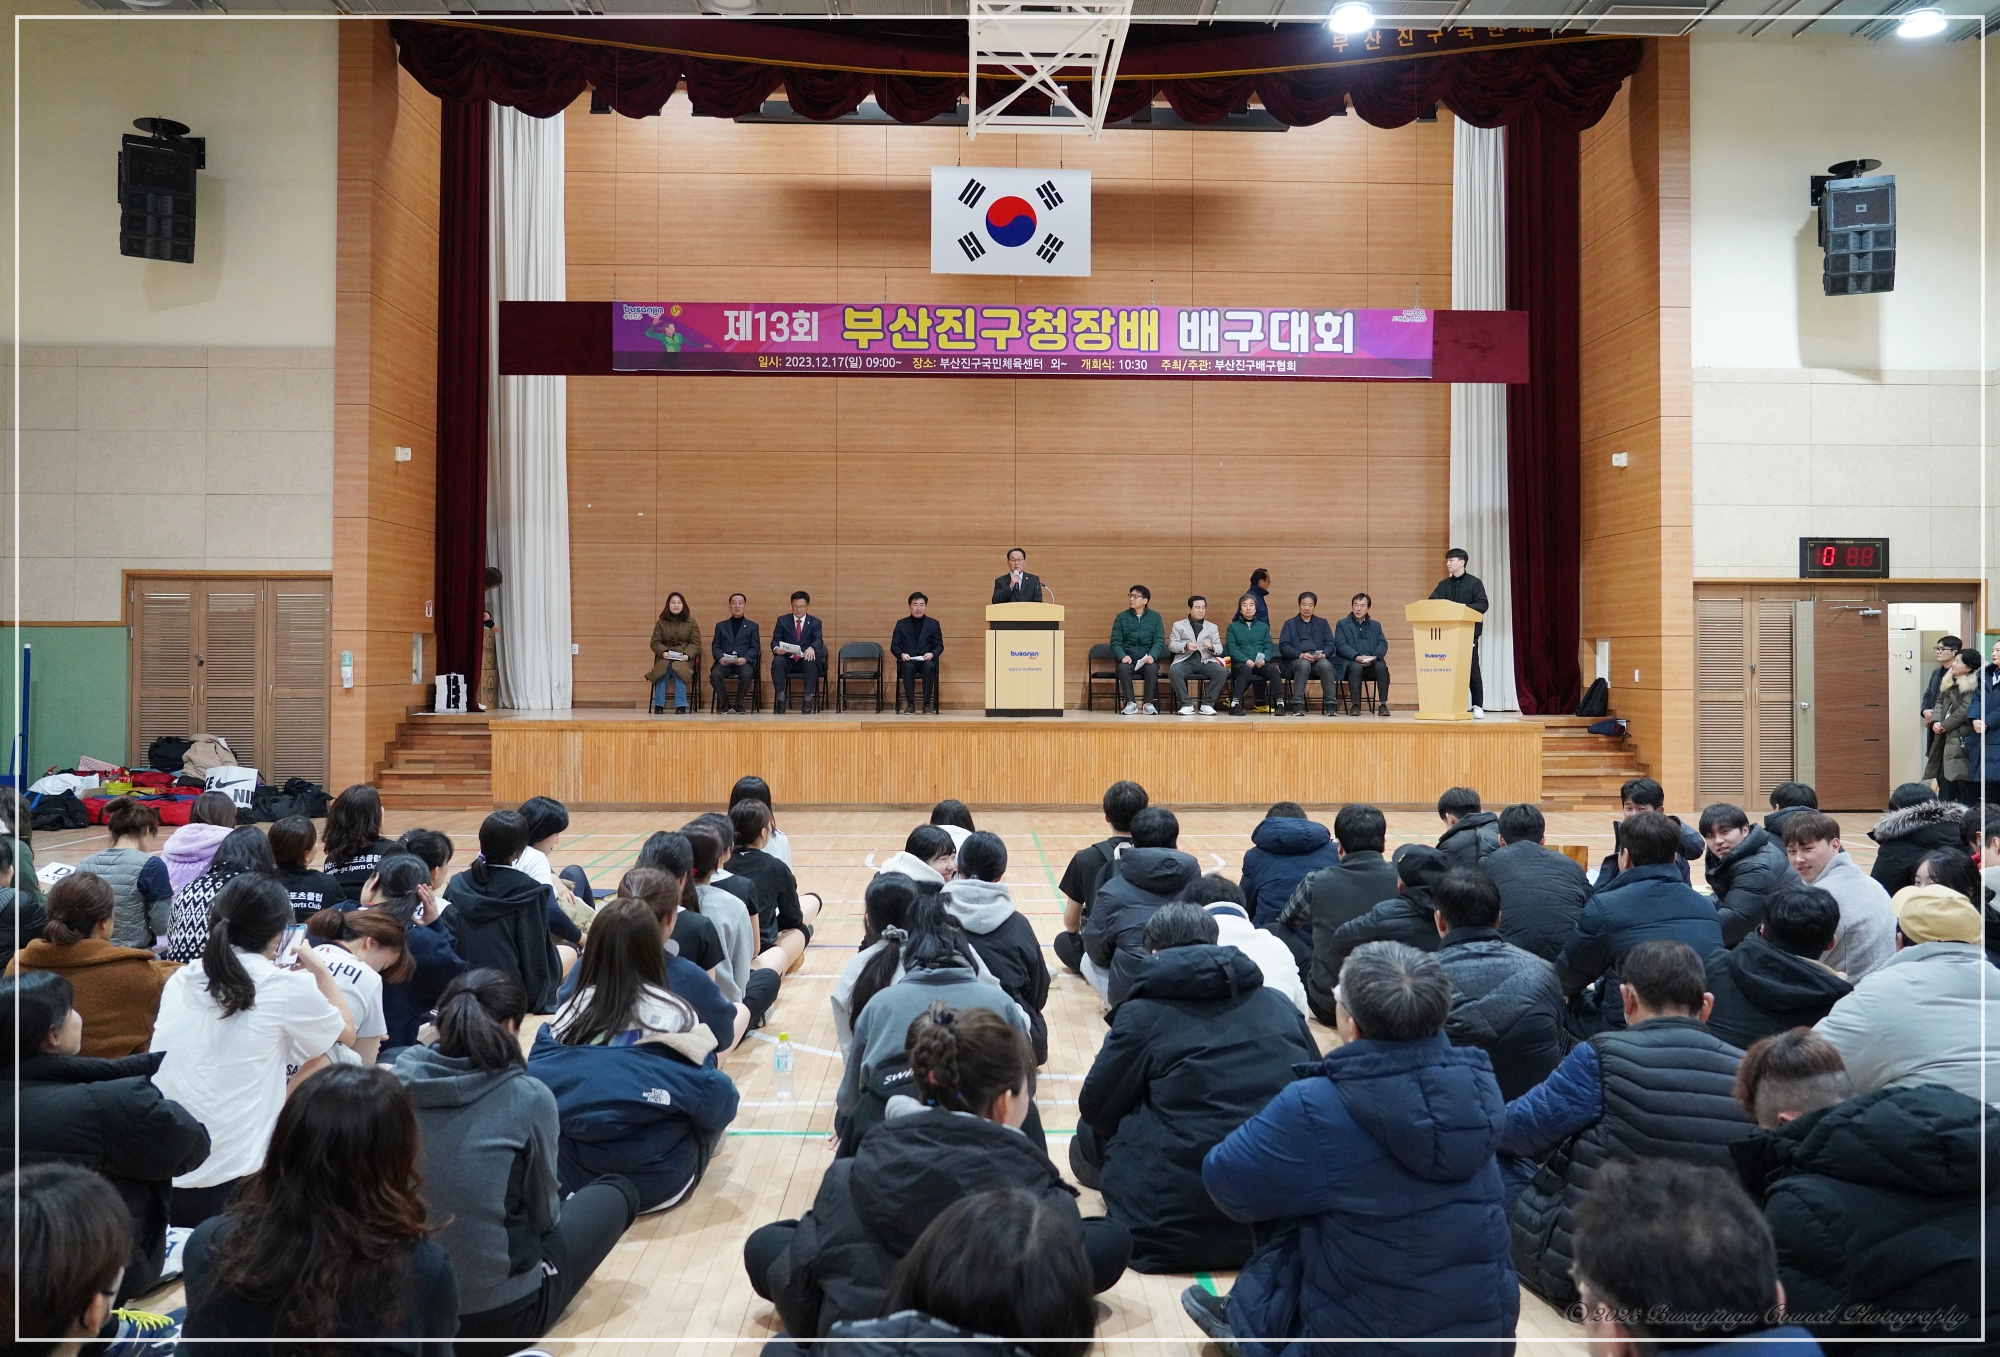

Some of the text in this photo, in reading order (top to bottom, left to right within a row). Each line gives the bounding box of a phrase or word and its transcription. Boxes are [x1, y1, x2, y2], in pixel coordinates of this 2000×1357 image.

[724, 306, 1355, 354] 제13회 부산진구청장배 배구대회
[759, 356, 782, 368] 일시:
[785, 356, 862, 369] 2023.12.17(일)
[865, 357, 902, 368] 09:00~
[912, 357, 936, 369] 장소:
[939, 358, 1043, 370] 부산진구국민체육센터
[1081, 359, 1115, 371] 개회식:
[1119, 359, 1147, 370] 10:30
[1161, 360, 1211, 371] 주최/주관:
[1215, 360, 1296, 372] 부산진구배구협회
[289, 891, 324, 903] 포츠클럽
